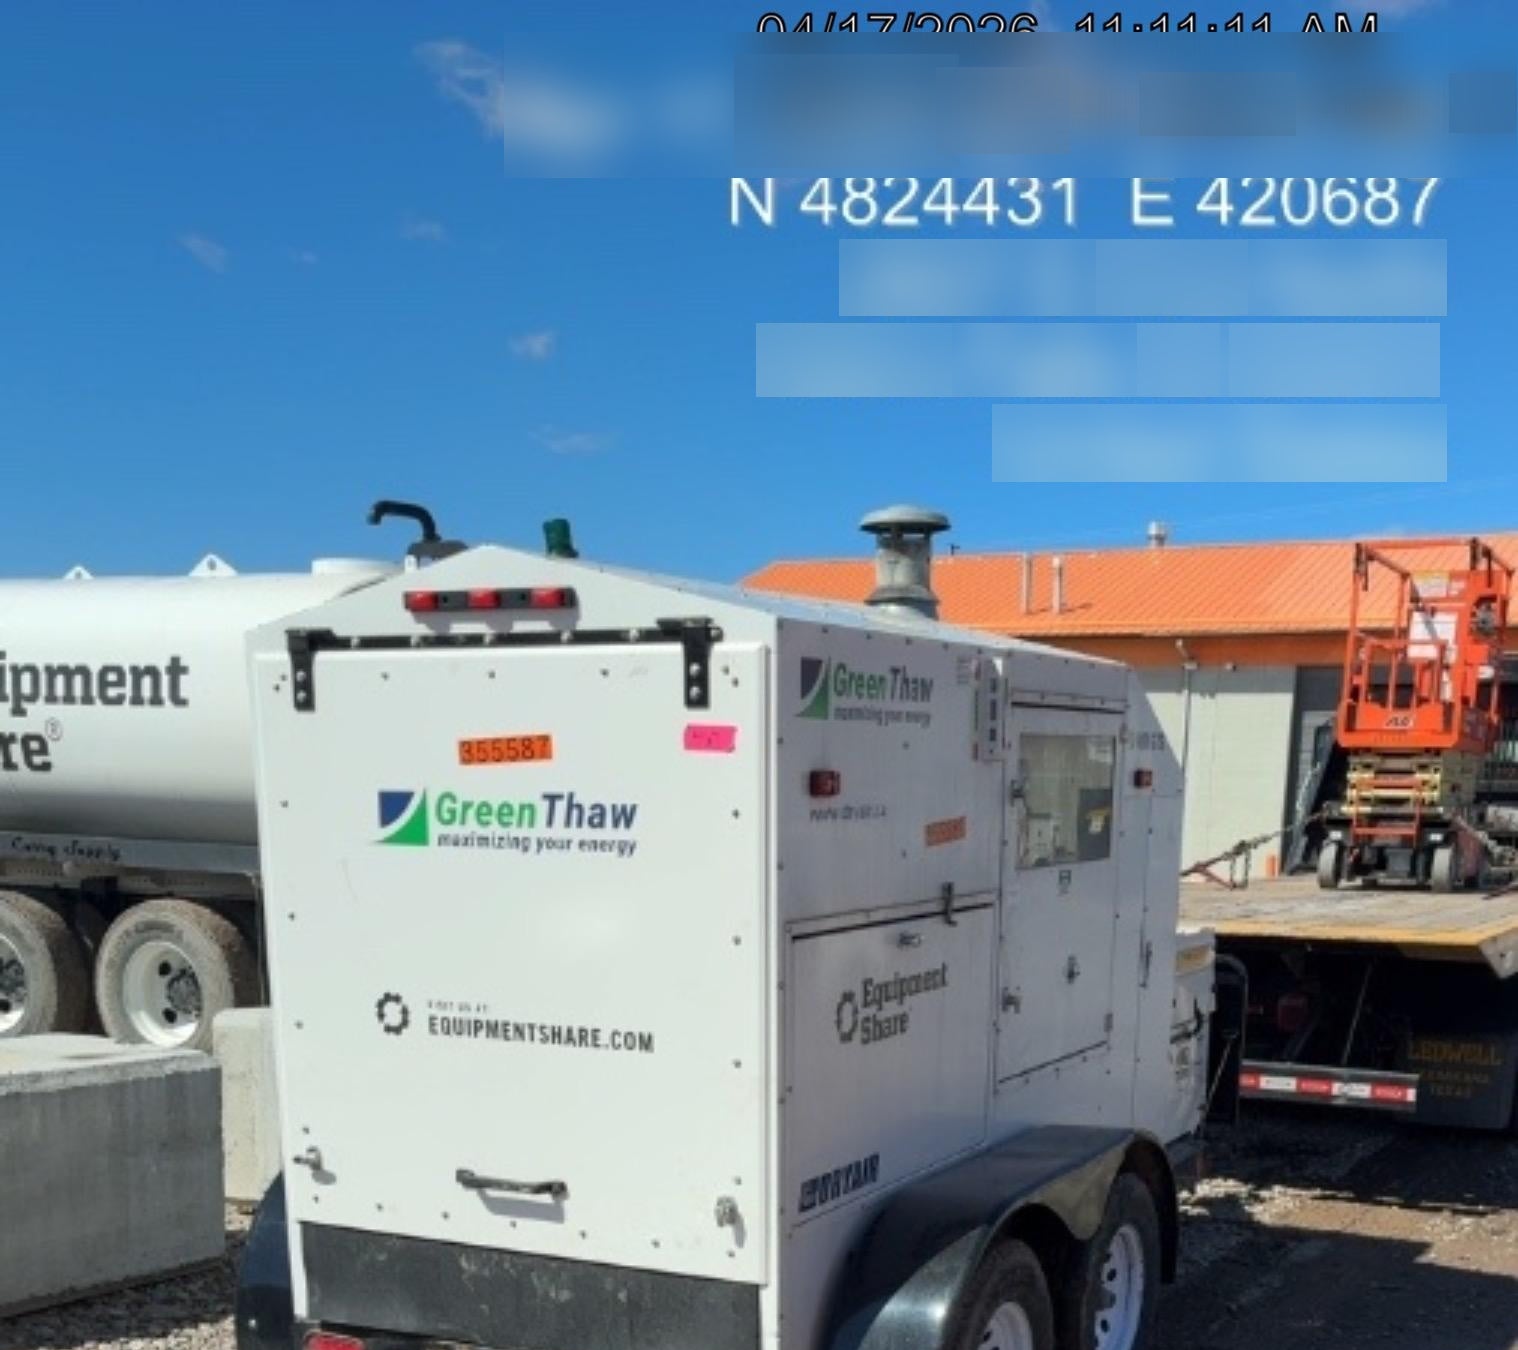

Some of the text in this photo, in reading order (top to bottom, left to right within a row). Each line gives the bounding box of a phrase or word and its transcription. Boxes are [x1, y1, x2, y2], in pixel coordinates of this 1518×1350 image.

[460, 735, 551, 764] 355587
[437, 830, 638, 857] maximizing your energy
[861, 961, 948, 1011] Equipment
[427, 1014, 655, 1053] EQUIPMENTSHARE.COM
[861, 1012, 910, 1045] Share
